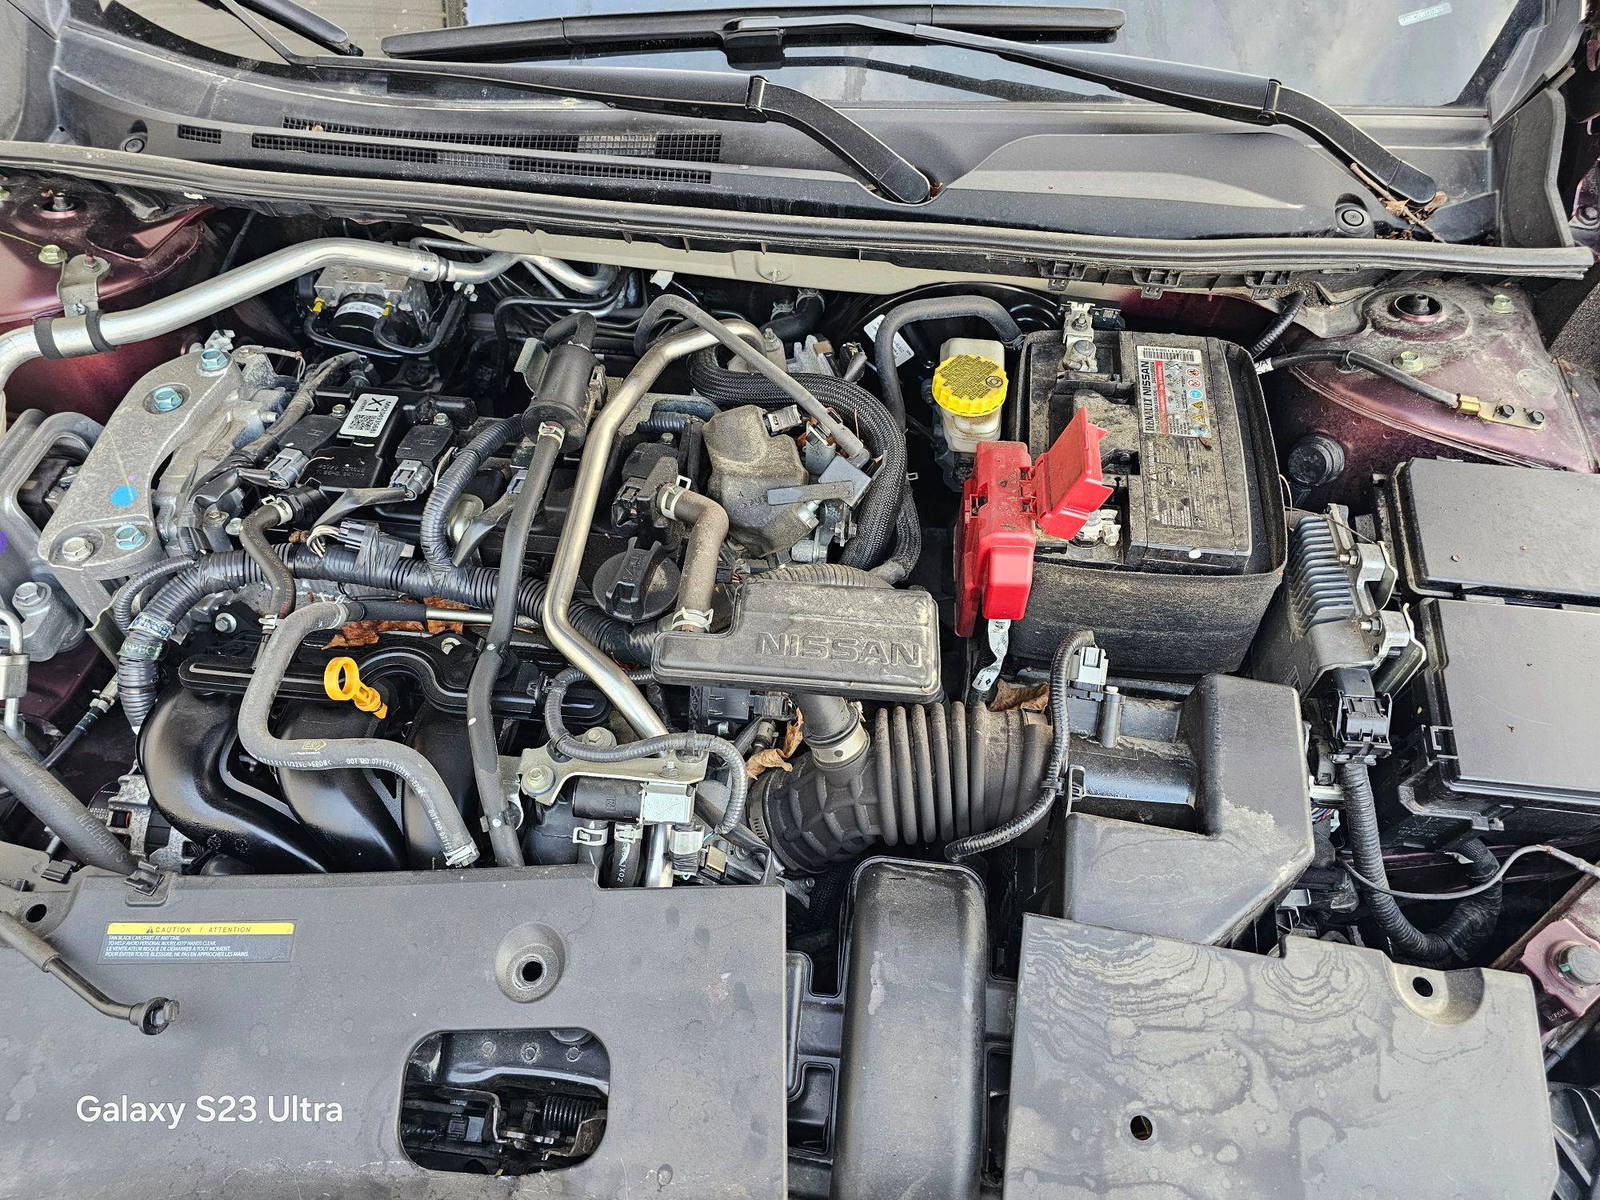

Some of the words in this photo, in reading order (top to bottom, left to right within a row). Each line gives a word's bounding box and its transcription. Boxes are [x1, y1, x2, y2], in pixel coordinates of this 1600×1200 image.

[1141, 361, 1152, 396] NISSAN
[365, 397, 386, 412] X1
[1143, 399, 1155, 432] RENAULT
[756, 631, 922, 667] NISSAN
